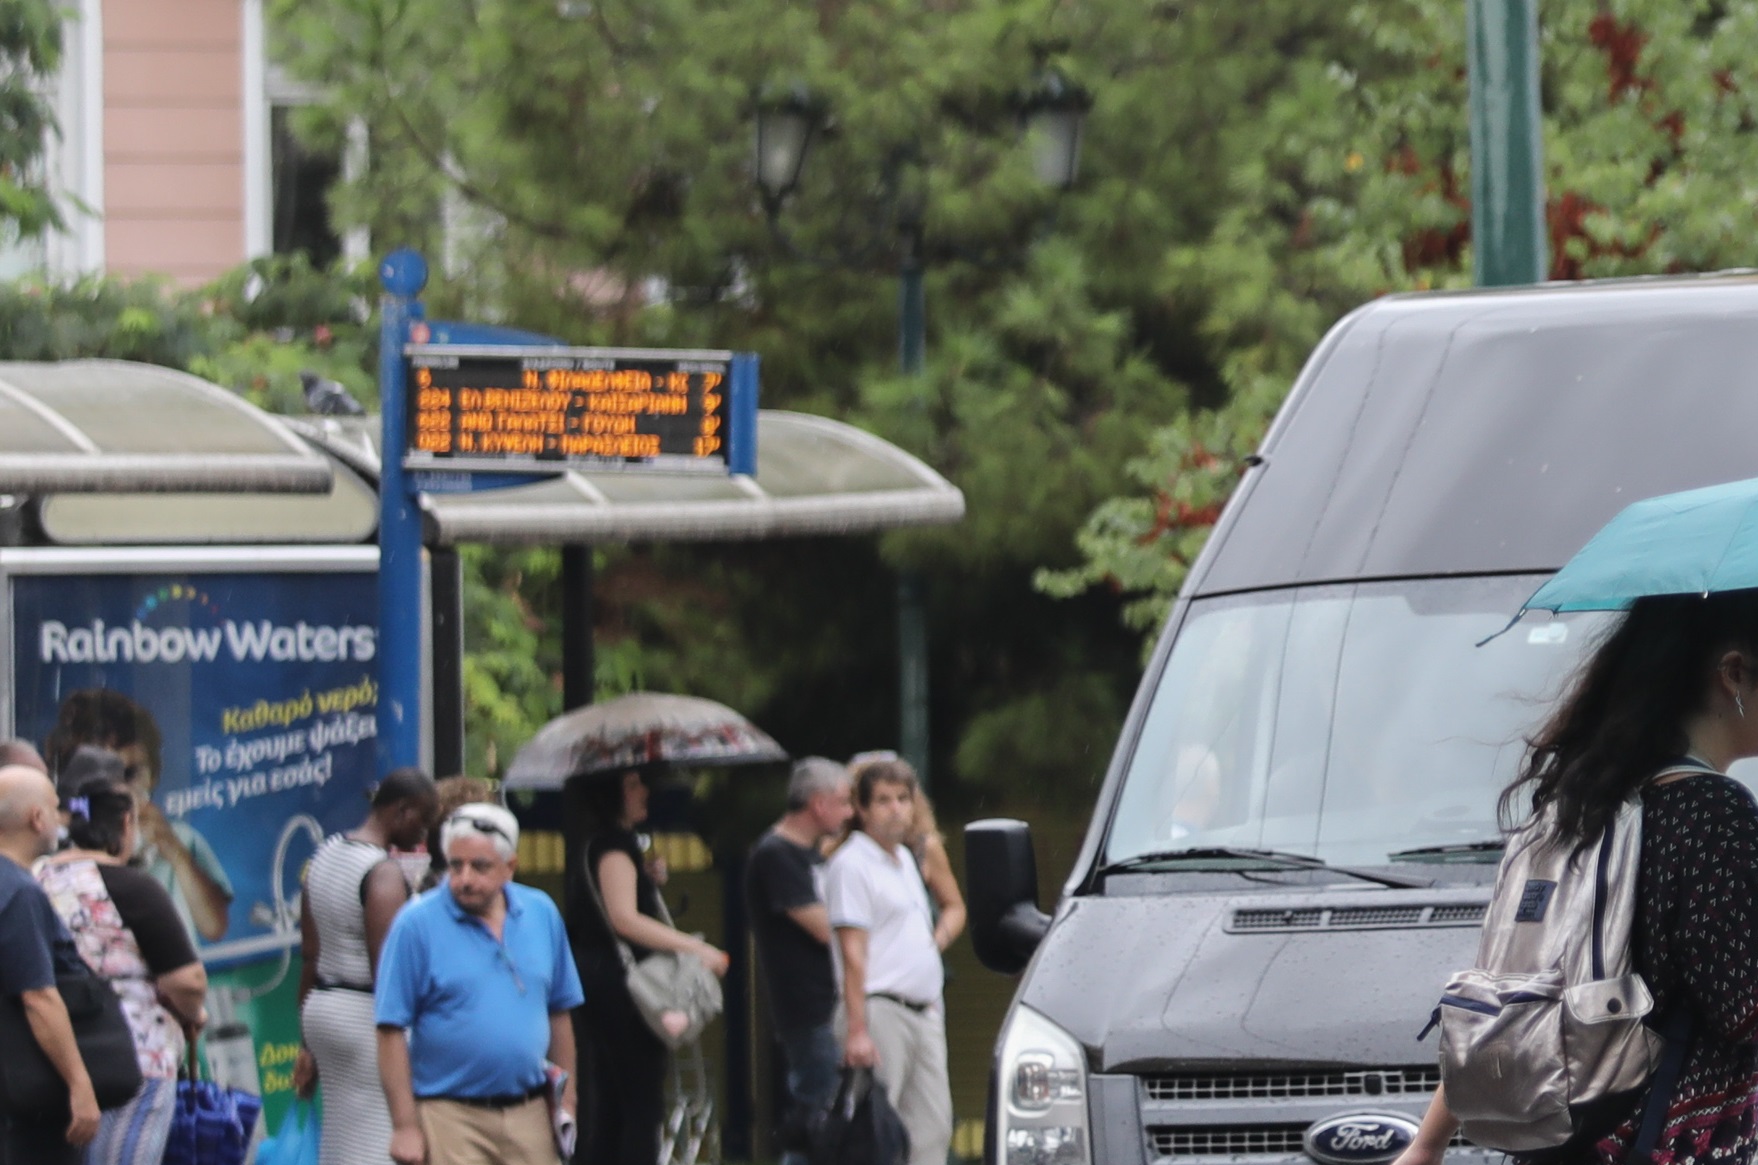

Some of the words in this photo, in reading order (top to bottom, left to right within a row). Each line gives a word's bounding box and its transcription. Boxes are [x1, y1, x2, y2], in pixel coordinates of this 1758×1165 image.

[40, 619, 221, 663] Rainbow
[226, 619, 375, 662] Waters
[222, 687, 313, 734] Καθαρό
[195, 744, 222, 775] Το
[224, 730, 306, 772] έχουμε
[164, 777, 224, 818] εμείς
[227, 771, 266, 806] για
[270, 751, 332, 792] εσάς!
[1330, 1122, 1395, 1151] Ford
